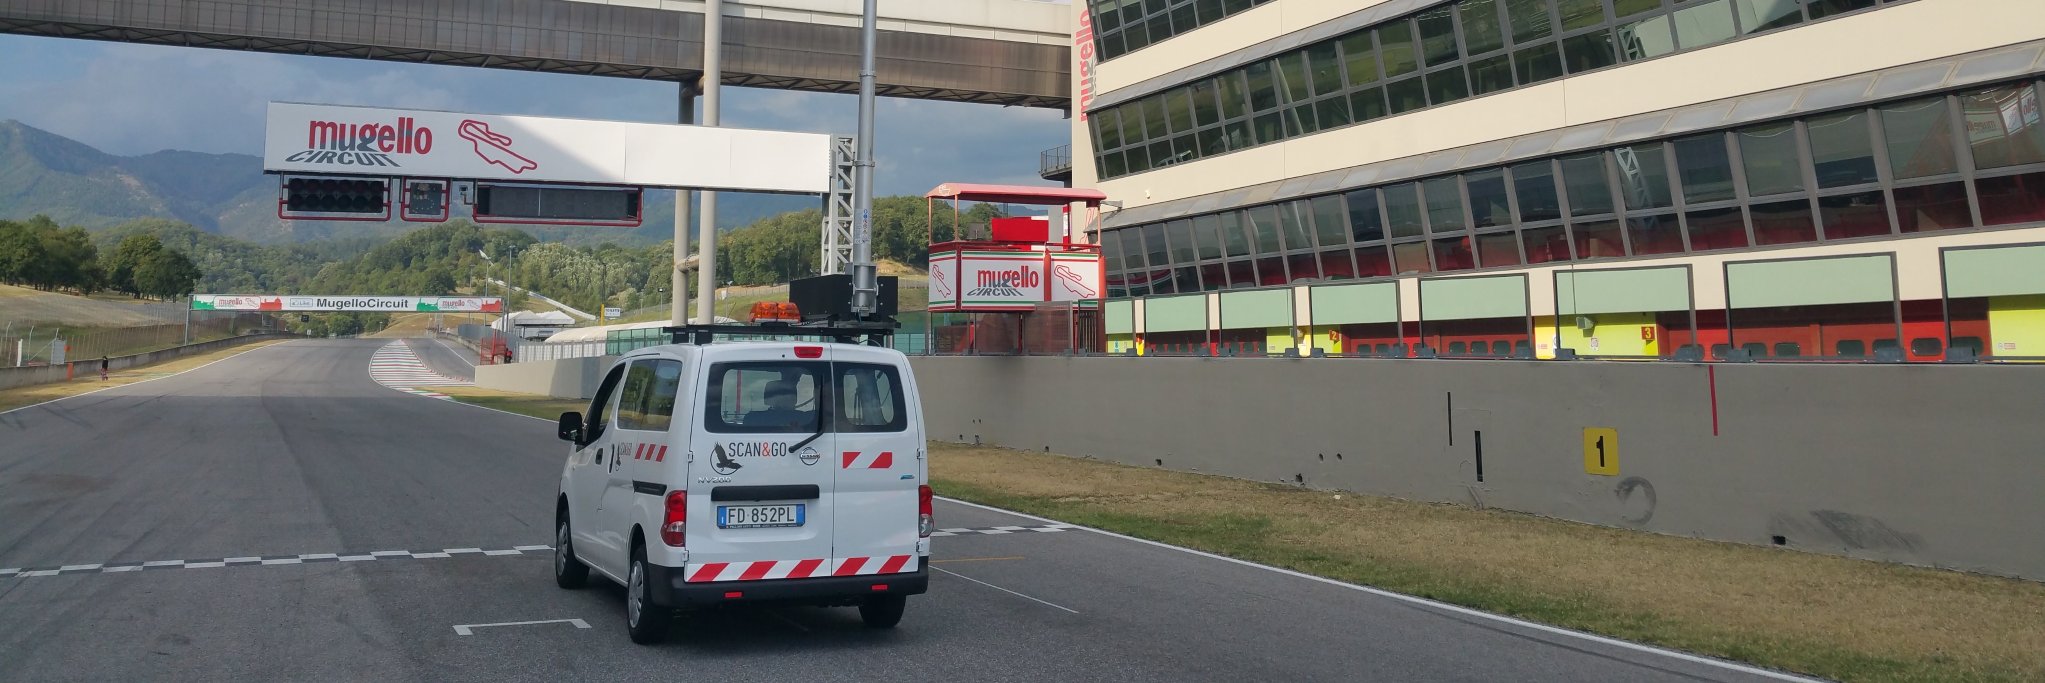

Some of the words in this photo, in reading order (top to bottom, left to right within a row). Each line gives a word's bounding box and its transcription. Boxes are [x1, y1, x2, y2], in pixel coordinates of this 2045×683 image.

[309, 117, 433, 155] mugello
[285, 149, 402, 168] CIRCUIT
[977, 265, 1039, 288] mugello
[966, 286, 1024, 297] CIRCUIT
[316, 298, 409, 310] MugelloCircuit
[1645, 327, 1652, 339] 3
[728, 441, 787, 458] SCAN&GO
[1596, 435, 1605, 468] 1
[697, 476, 732, 484] NV200
[728, 508, 745, 523] FD
[751, 507, 795, 523] 852PL
